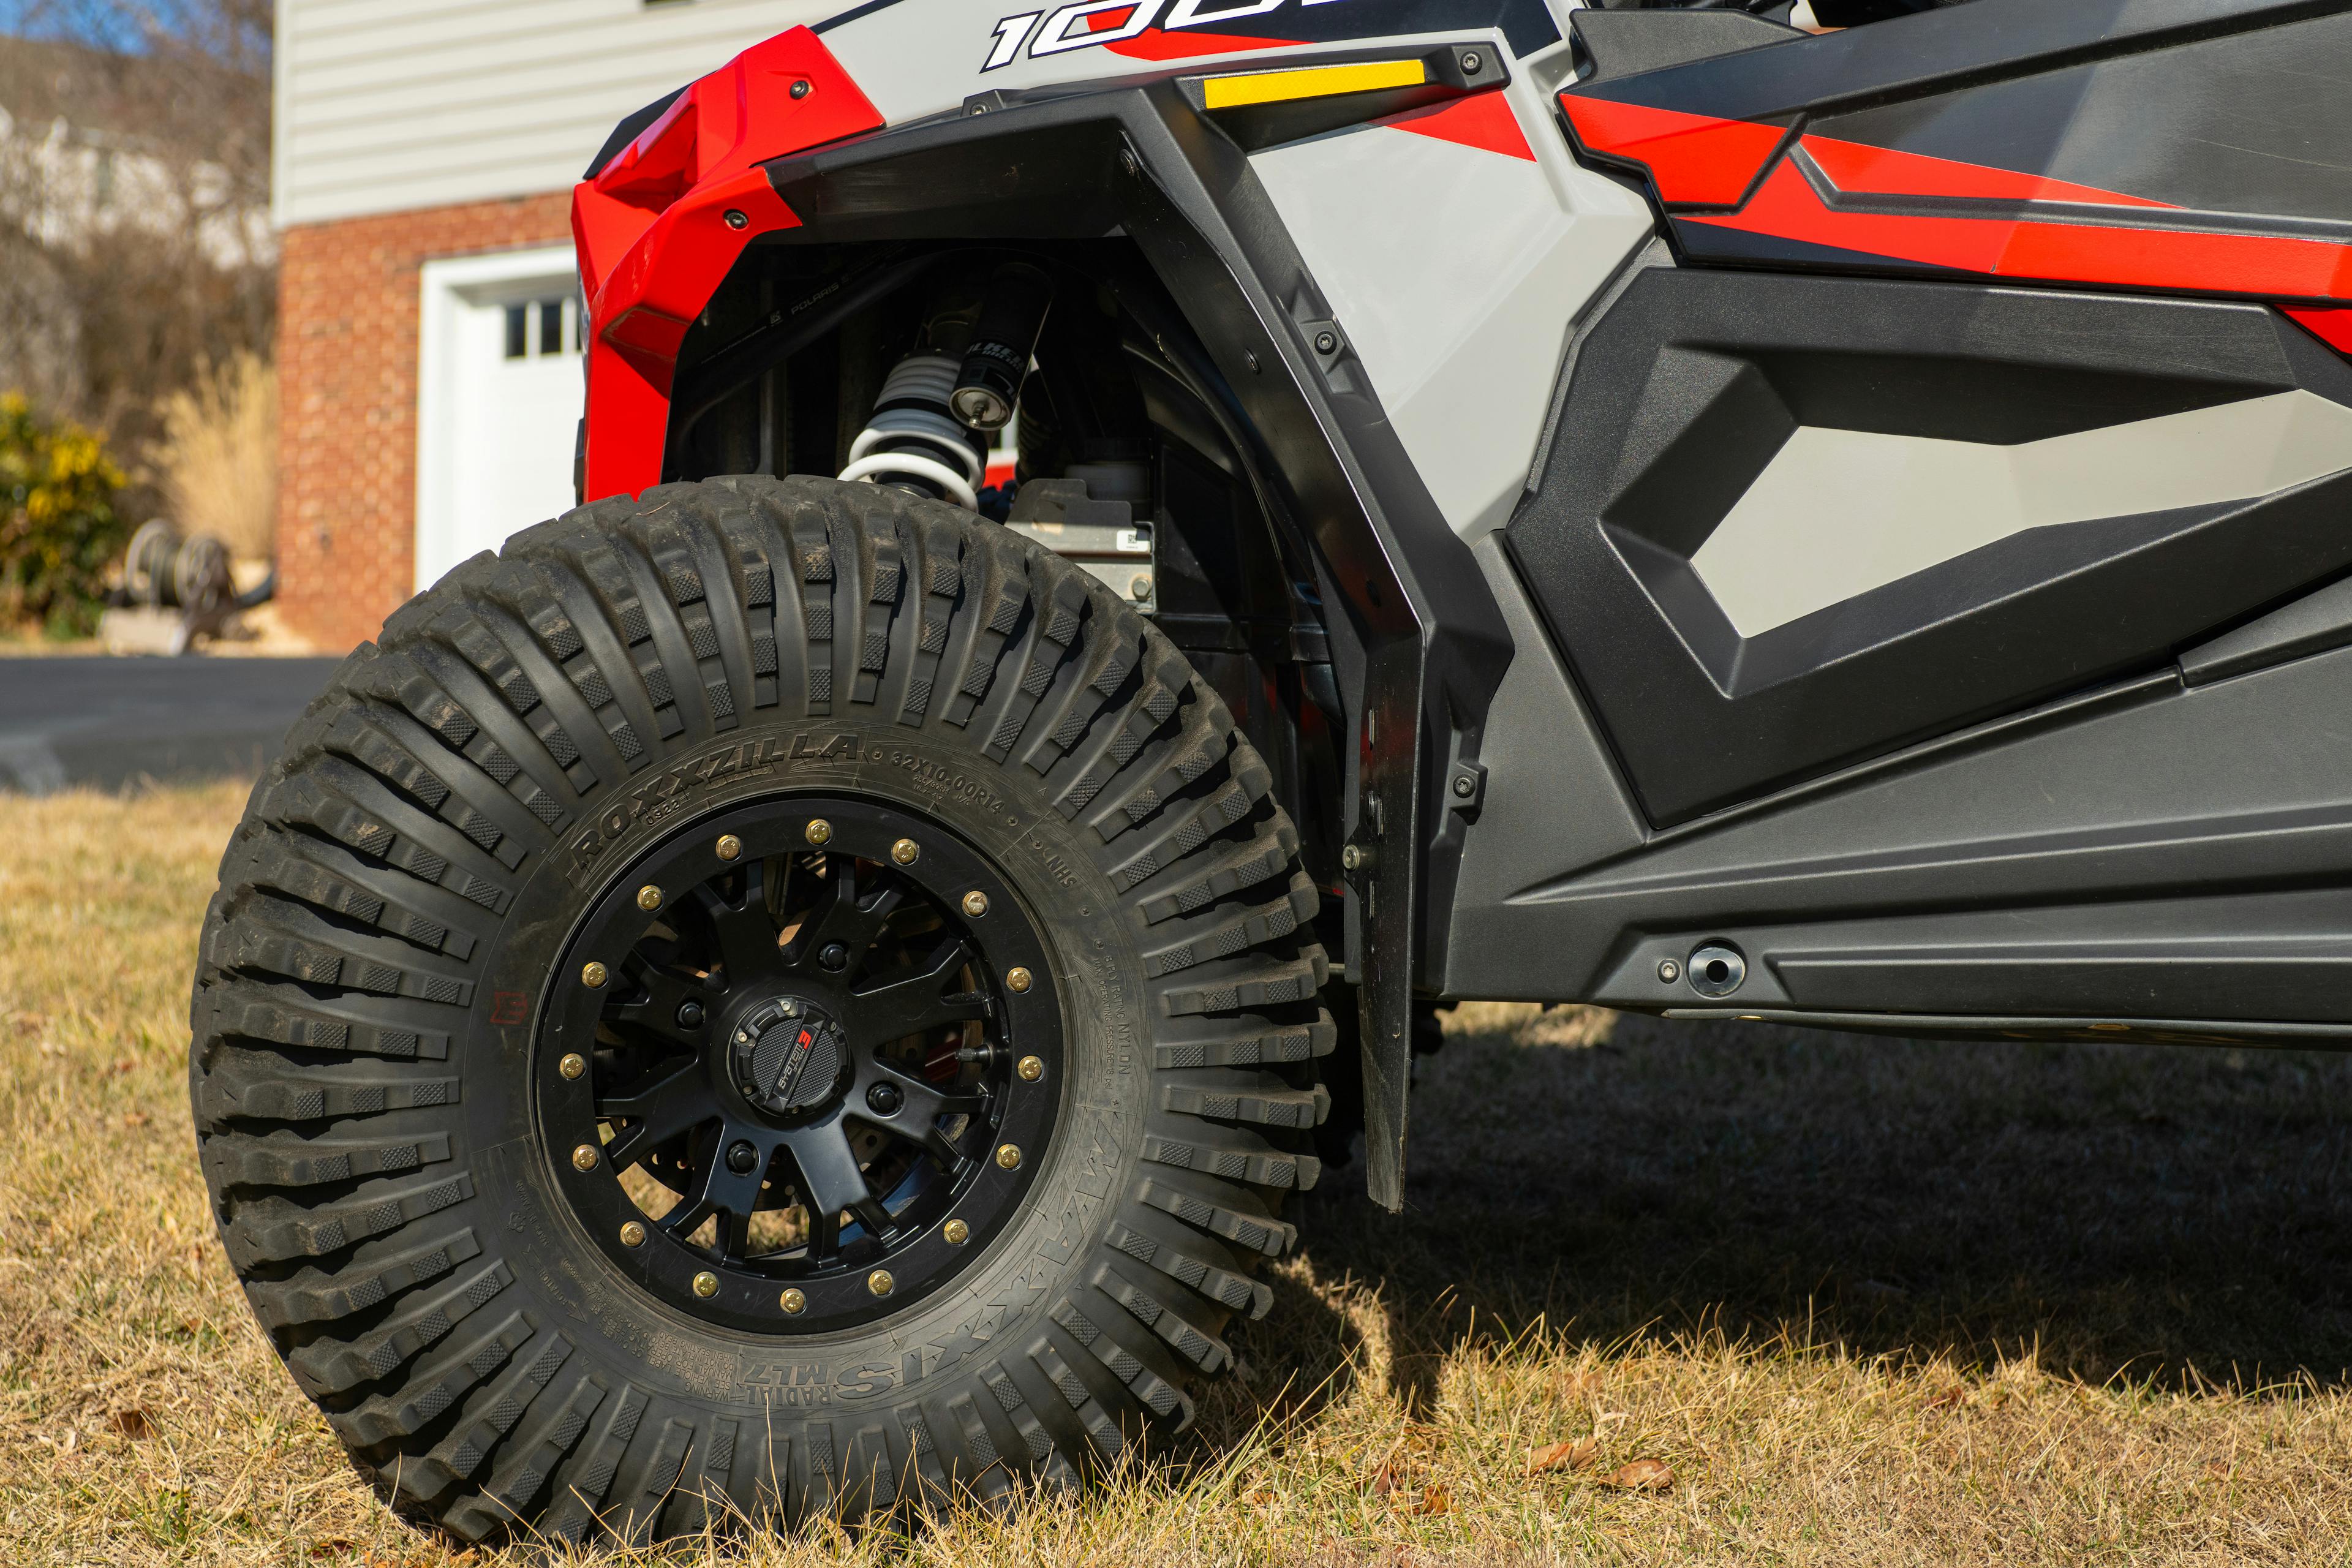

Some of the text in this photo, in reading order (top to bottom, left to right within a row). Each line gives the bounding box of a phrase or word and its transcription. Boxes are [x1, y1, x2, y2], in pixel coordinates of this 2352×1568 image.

[791, 282, 840, 315] POLARIS
[571, 734, 858, 865] ROXXZILLA
[1047, 855, 1077, 889] NHS
[1098, 980, 1112, 1022] OPERATING
[1102, 954, 1131, 1074] 8 PLY RATING NYLON
[1104, 1025, 1115, 1063] PRESSURE
[1104, 1079, 1113, 1089] psi
[515, 1180, 550, 1247] MADE IN TAIWAN
[836, 1119, 1121, 1399] MAXXIS
[538, 1269, 569, 1305] ROTATION
[627, 1332, 674, 1362] OPERATING
[641, 1330, 670, 1350] BEYOND
[658, 1330, 734, 1363] WHEN SEATING BEAD
[629, 1345, 644, 1359] OR
[643, 1353, 672, 1373] LABEL
[671, 1345, 702, 1363] INFLATE
[675, 1356, 694, 1370] FOR
[704, 1357, 720, 1368] NOT
[674, 1366, 710, 1386] VEHICLE
[696, 1363, 733, 1381] MANUAL
[722, 1362, 734, 1371] DO
[744, 1361, 829, 1386] ML7
[683, 1381, 729, 1402] WARNING
[713, 1378, 731, 1391] SEE
[742, 1384, 833, 1407] RADIAL
